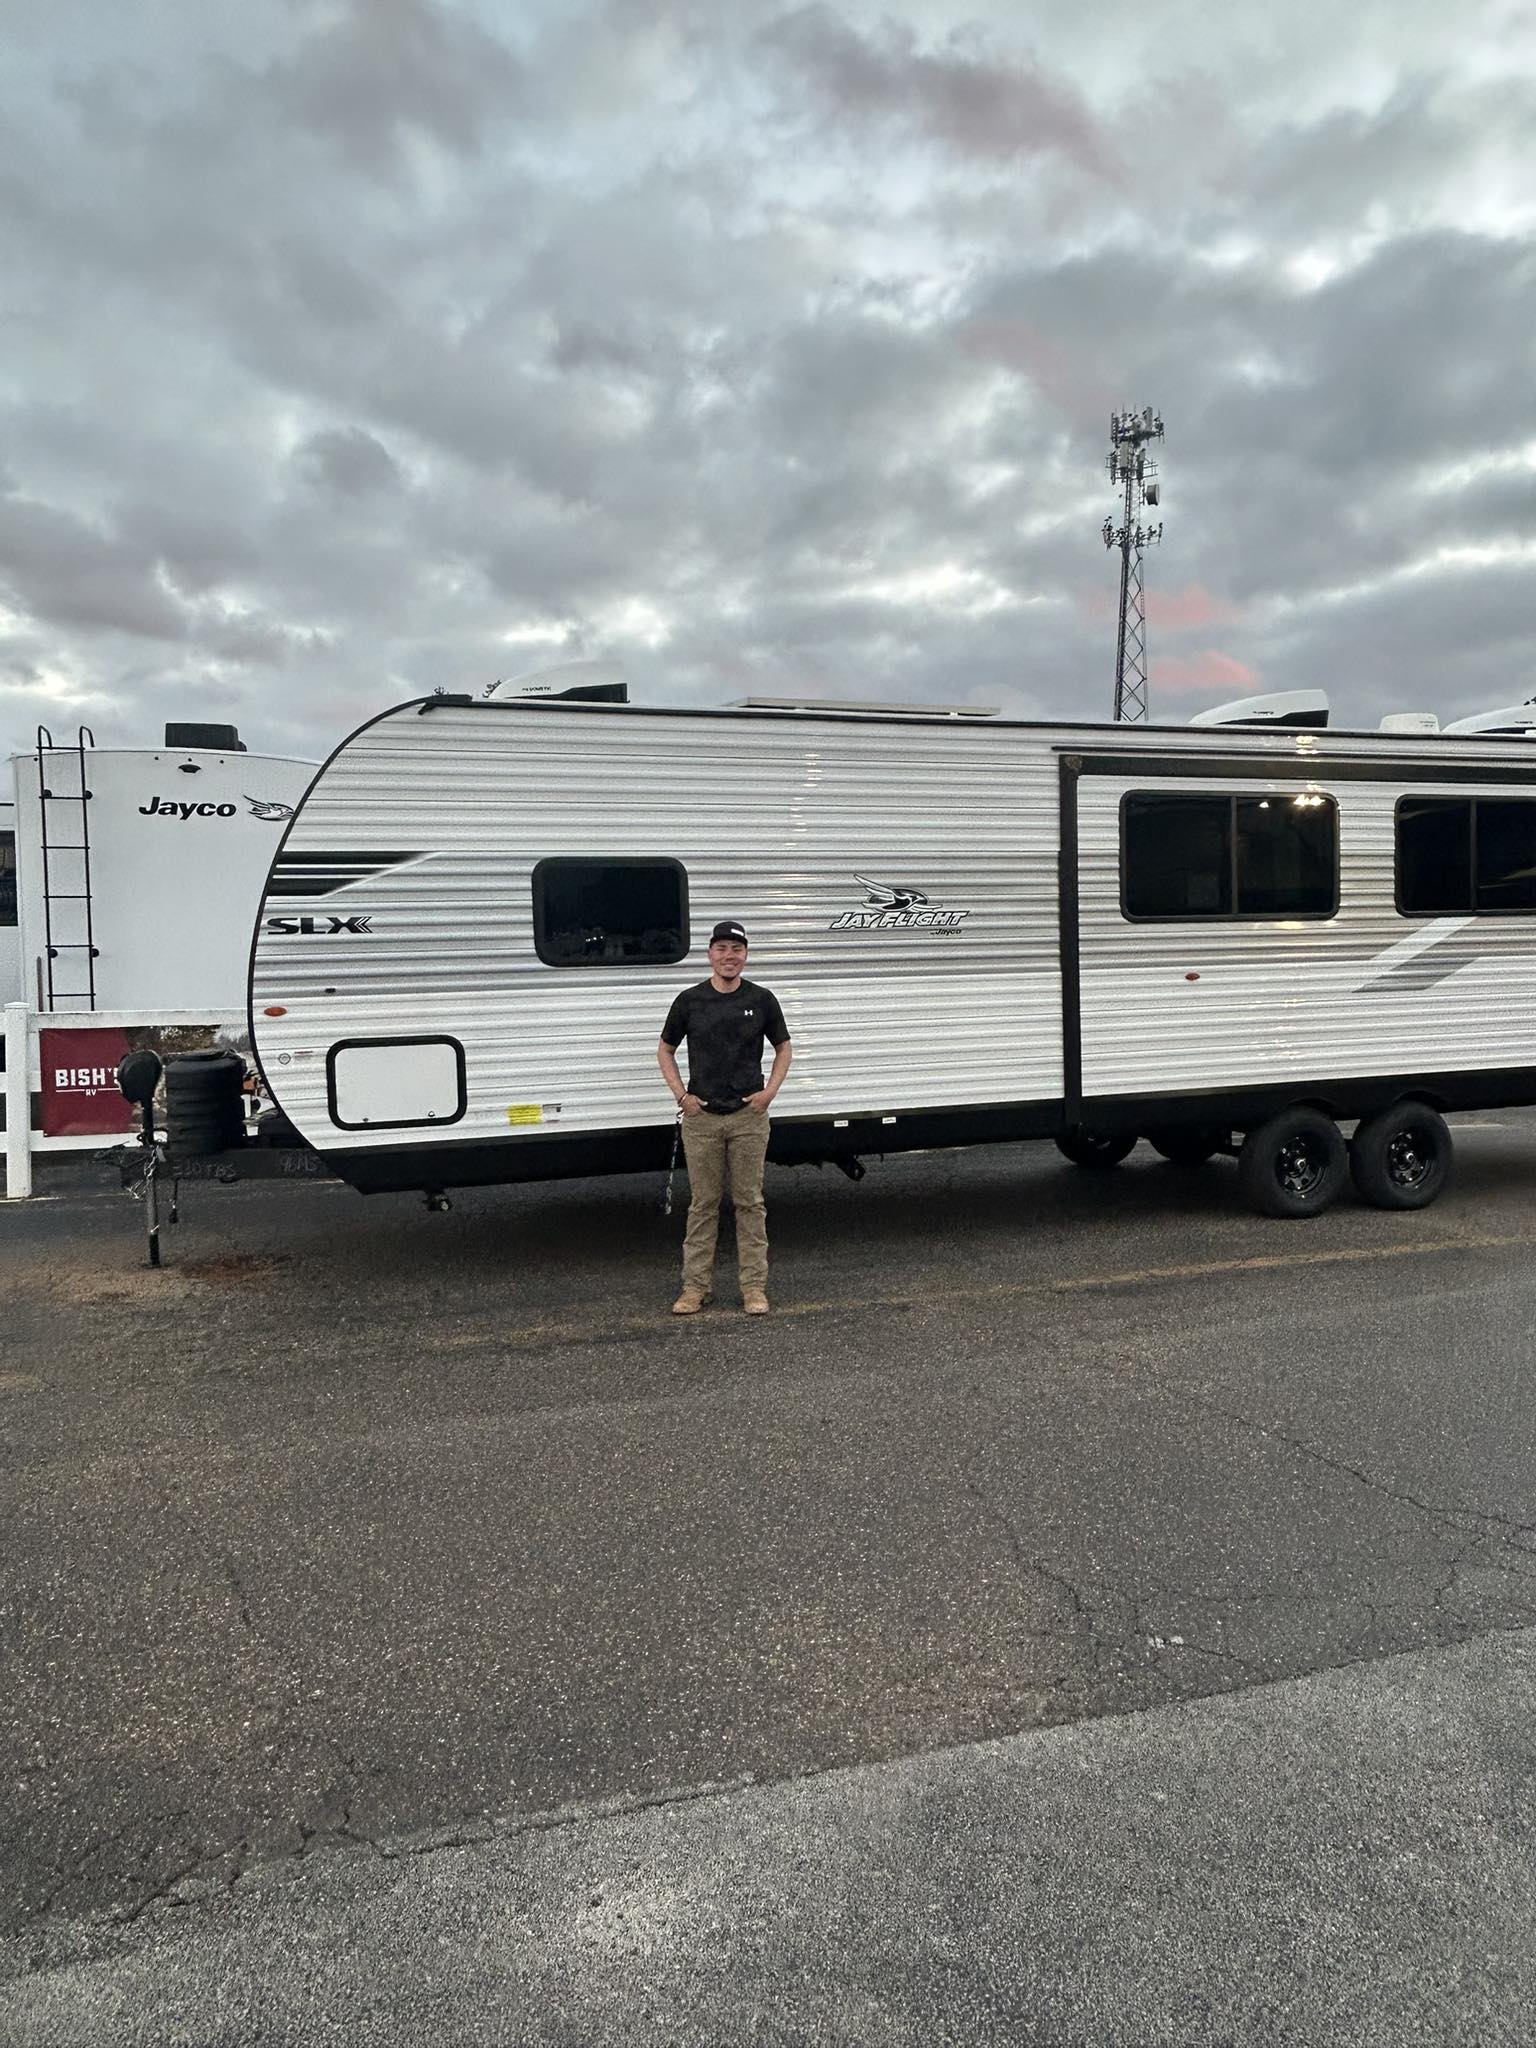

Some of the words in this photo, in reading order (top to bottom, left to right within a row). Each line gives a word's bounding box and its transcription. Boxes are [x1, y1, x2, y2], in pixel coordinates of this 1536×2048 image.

[138, 796, 237, 821] Jayco
[266, 915, 373, 935] SLX
[85, 1089, 97, 1097] RV
